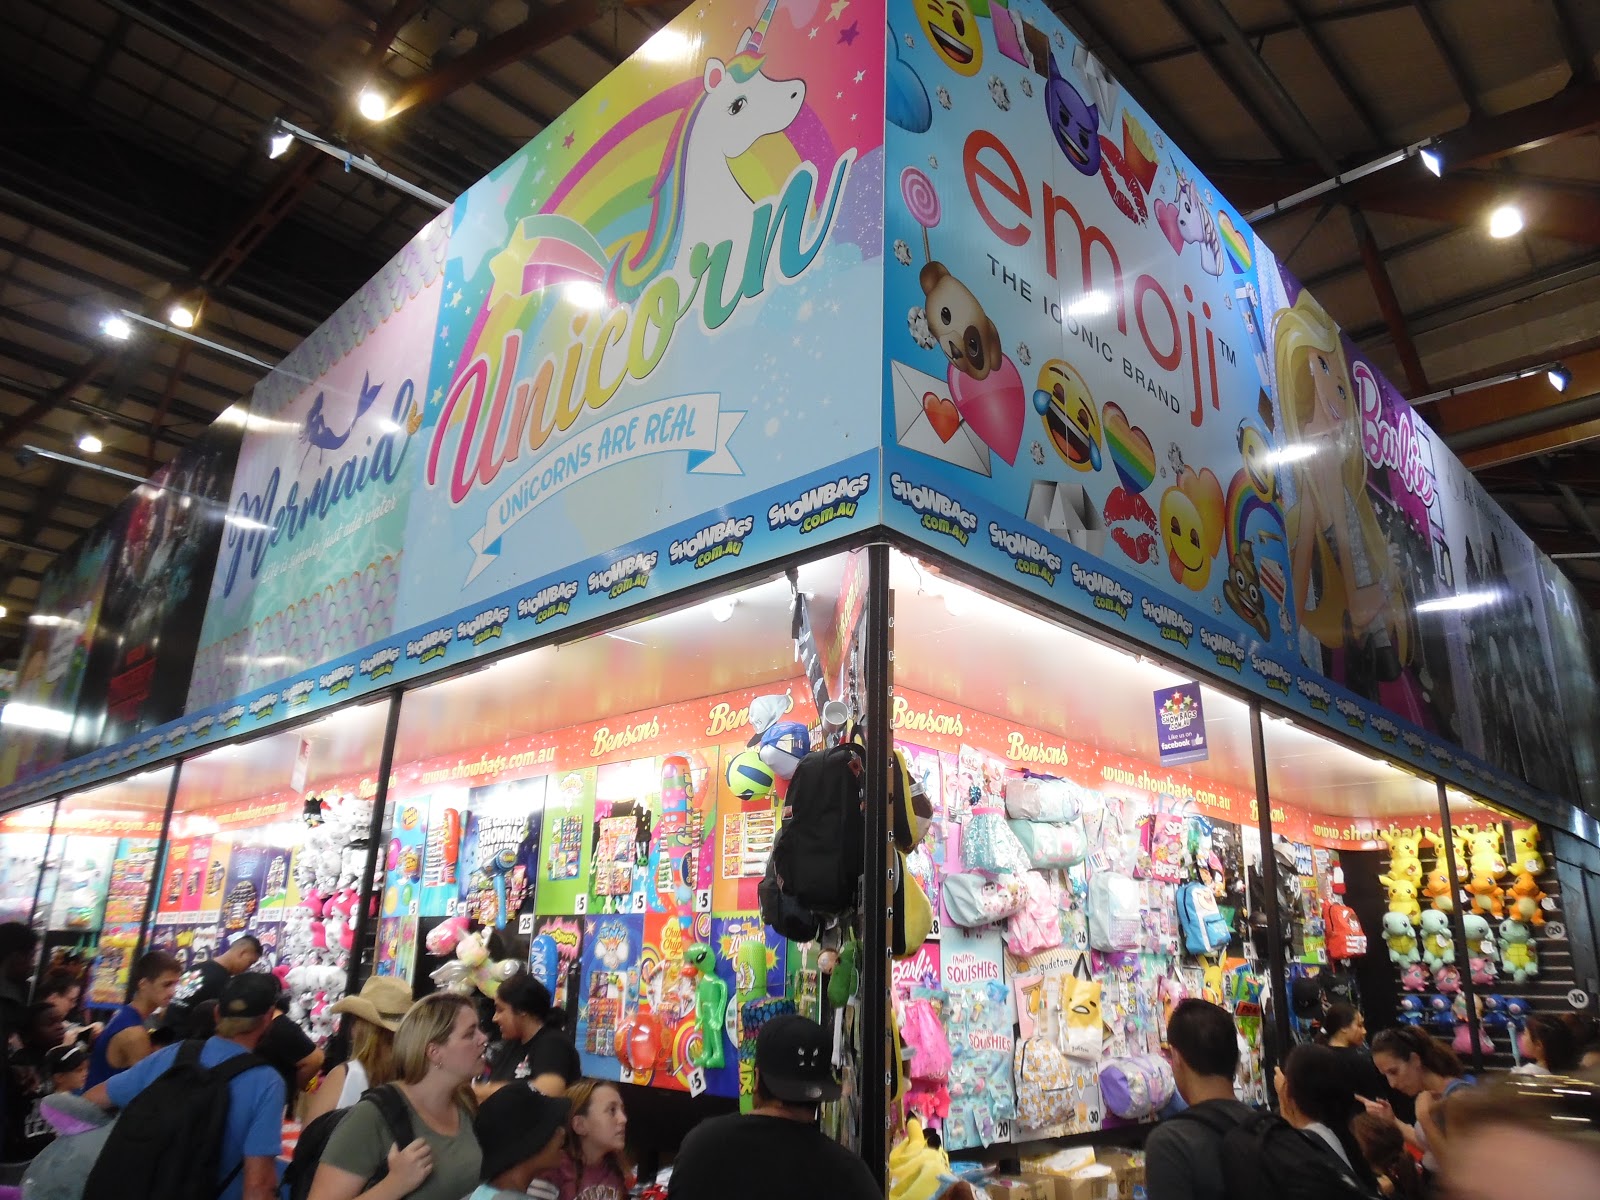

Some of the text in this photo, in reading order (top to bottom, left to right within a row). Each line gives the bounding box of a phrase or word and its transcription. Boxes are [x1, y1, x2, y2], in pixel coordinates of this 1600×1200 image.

[963, 129, 1220, 428] emoji
[426, 155, 854, 505] Unicorn
[987, 253, 1180, 415] THE ICONIC BRAND
[598, 415, 637, 462] ARE
[644, 404, 696, 447] REAL
[1353, 360, 1434, 507] Barbie
[224, 378, 414, 598] Mermaid
[768, 474, 869, 527] SHOWBAGS
[891, 473, 977, 529] SHOWBAGS
[670, 516, 753, 562] SHOWBAGS
[990, 523, 1061, 570] SHOWBAGS
[588, 551, 657, 592] SHOWBAGS
[1072, 564, 1133, 606] SHOWBAGS
[518, 581, 578, 615] SHOWBAGS
[1142, 598, 1193, 637] SHOWBAGS
[590, 716, 660, 757] Bensons
[893, 696, 963, 737] Bensons
[1006, 732, 1068, 767] Bensons
[1161, 739, 1191, 750] facebook
[420, 746, 556, 785] www.showbags.com.au
[1103, 765, 1231, 812] www.showbags.com.au
[479, 826, 525, 848] SHOWBAG
[893, 949, 937, 983] Barbie
[947, 962, 999, 984] SQUISHIES
[1039, 957, 1073, 975] gudetama
[968, 1031, 1012, 1051] SQUISHIES
